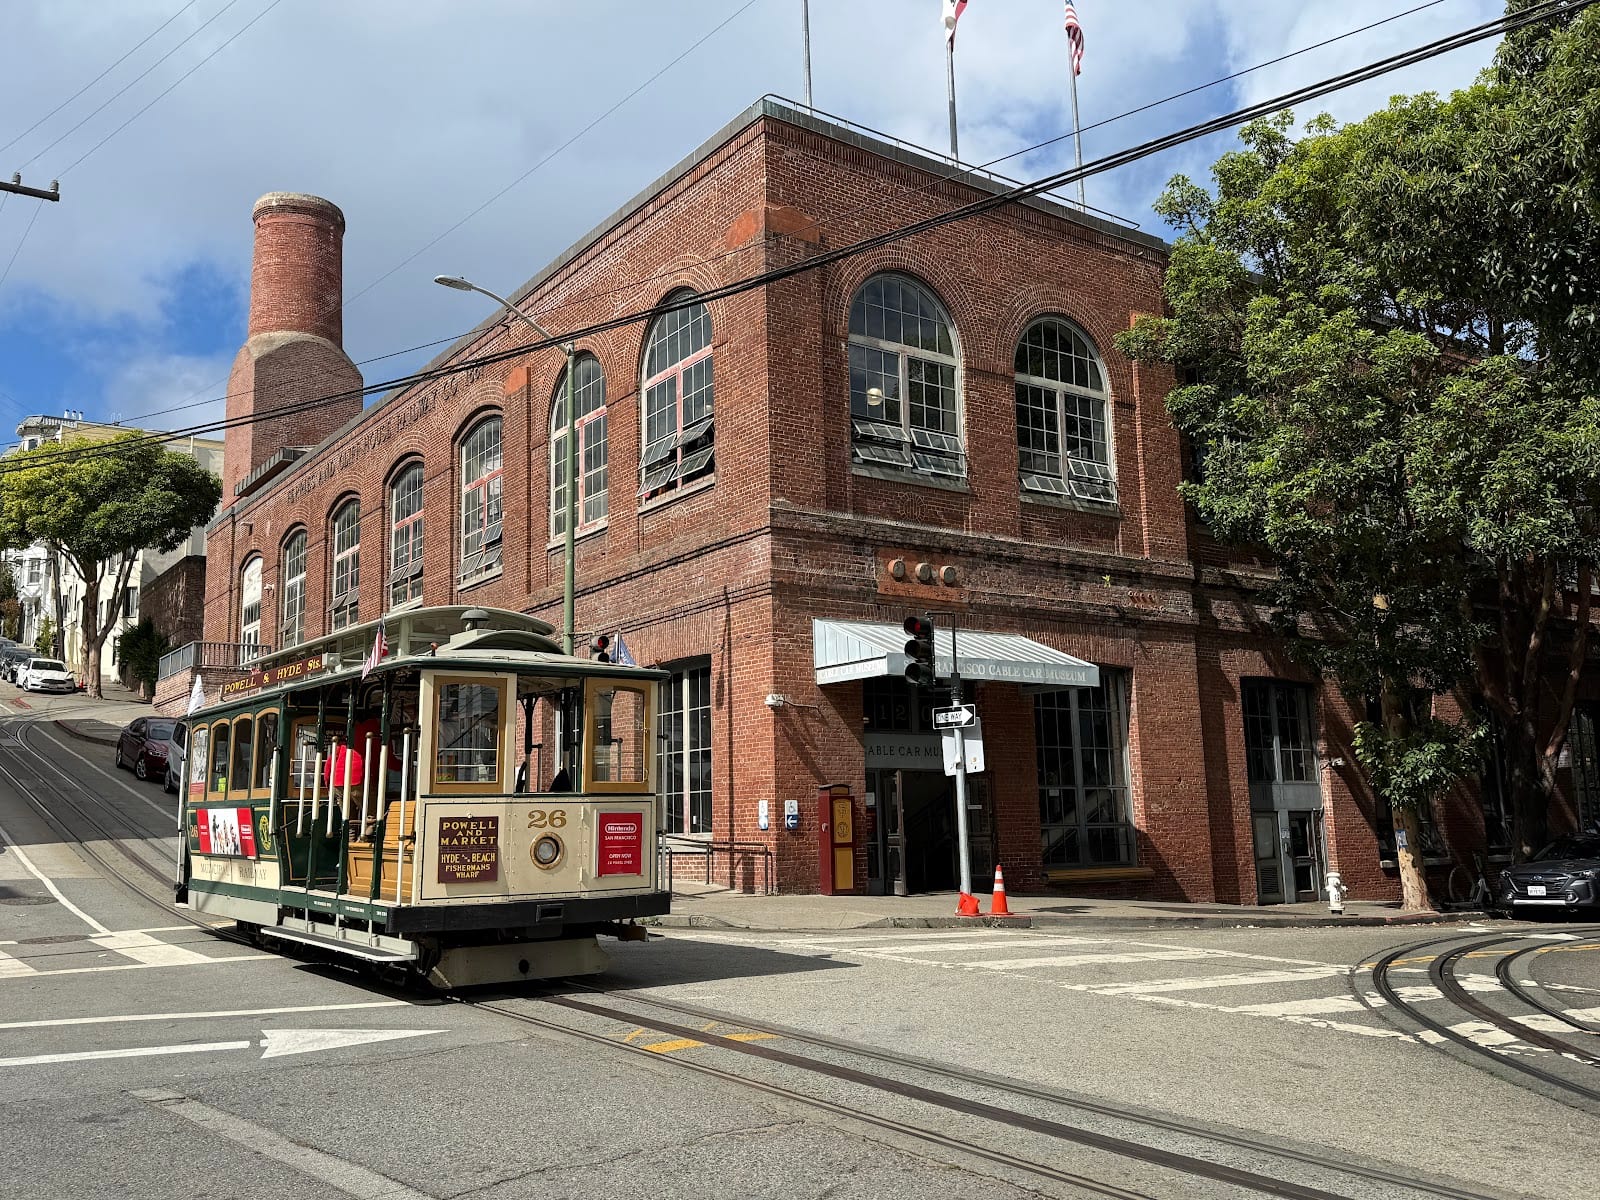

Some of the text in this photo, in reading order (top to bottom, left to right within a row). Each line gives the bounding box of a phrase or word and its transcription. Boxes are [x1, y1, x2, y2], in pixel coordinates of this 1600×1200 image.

[935, 661, 1087, 682] RANCISCO CABLE CAR MUSEUM
[223, 677, 257, 694] POWELL
[262, 673, 270, 684] &
[276, 663, 302, 680] HYDE
[950, 712, 962, 721] WAY
[898, 746, 921, 757] CAR
[527, 809, 567, 829] 26
[442, 821, 496, 831] POWELL
[440, 836, 497, 846] MARKET
[441, 853, 461, 864] HYDE
[471, 852, 496, 863] BEACH
[445, 863, 491, 873] FISHERMANS
[456, 871, 480, 879] WHARF
